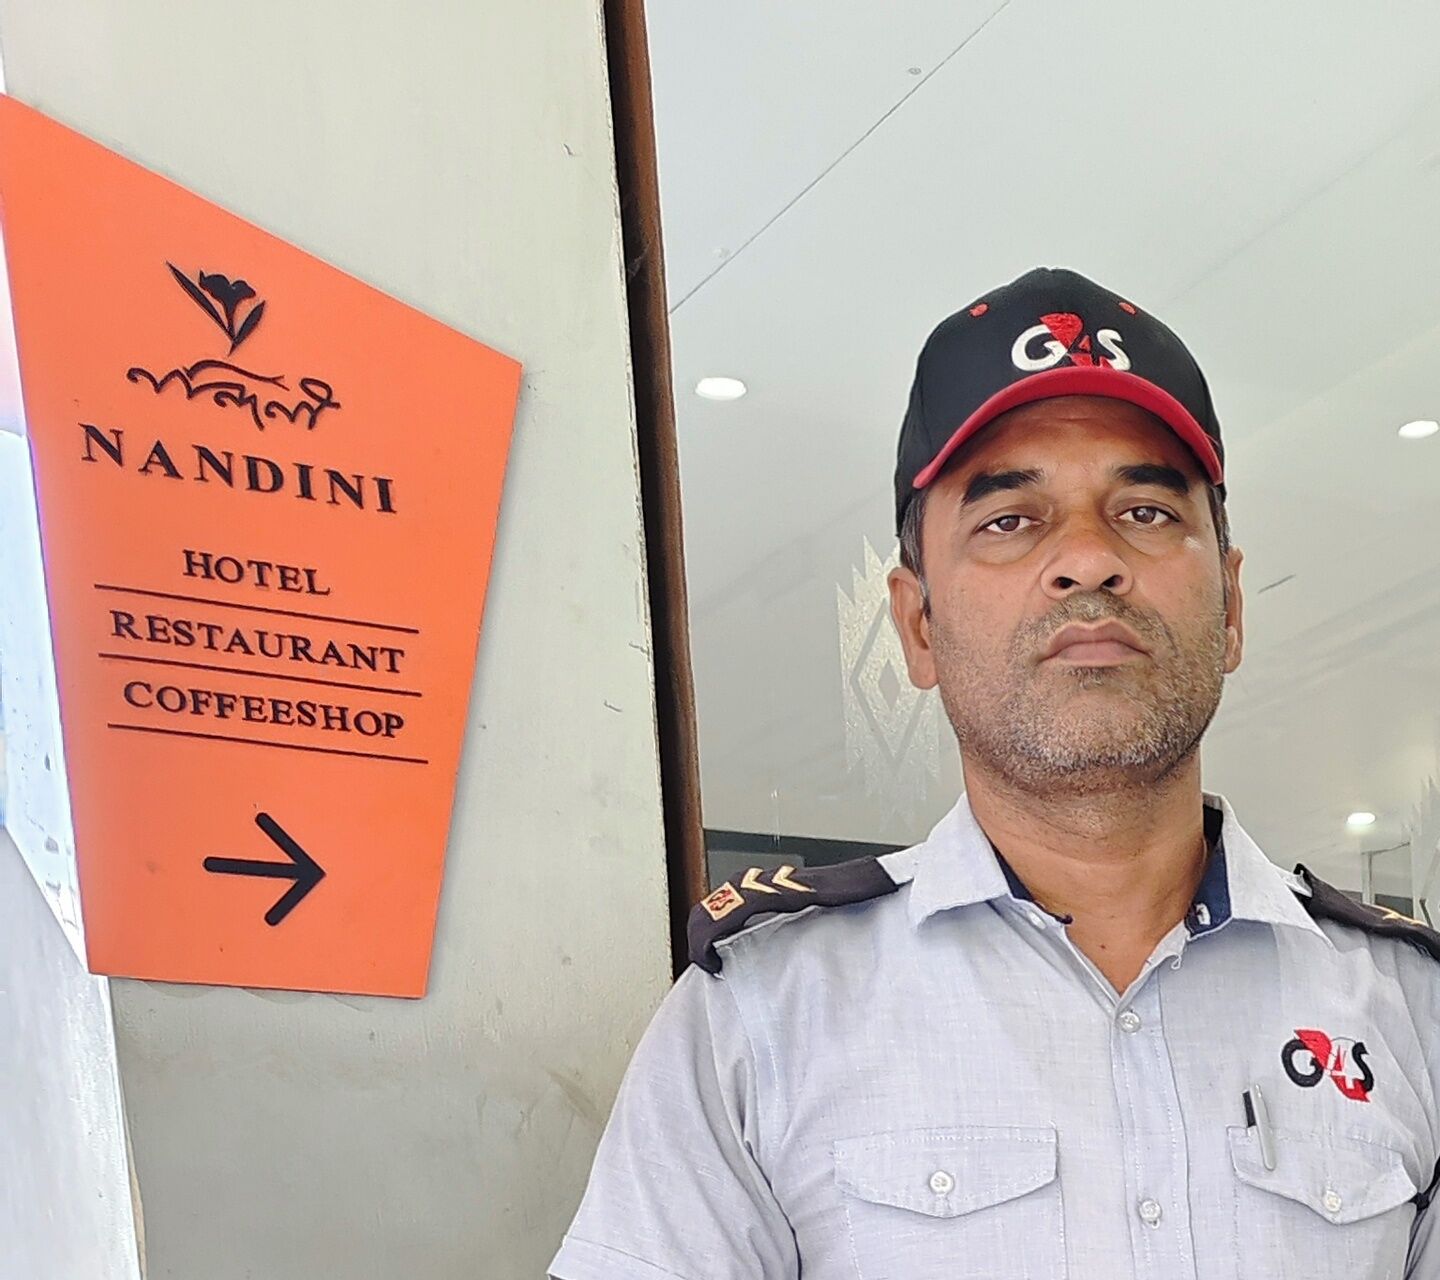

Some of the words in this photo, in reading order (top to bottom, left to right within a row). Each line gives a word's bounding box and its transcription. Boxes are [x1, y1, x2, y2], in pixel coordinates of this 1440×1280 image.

[77, 421, 398, 515] NANDINI
[182, 549, 331, 596] HOTEL
[109, 609, 405, 674] RESTAURANT
[123, 680, 405, 739] COFFEESHOP
[1281, 1025, 1375, 1104] G4S
